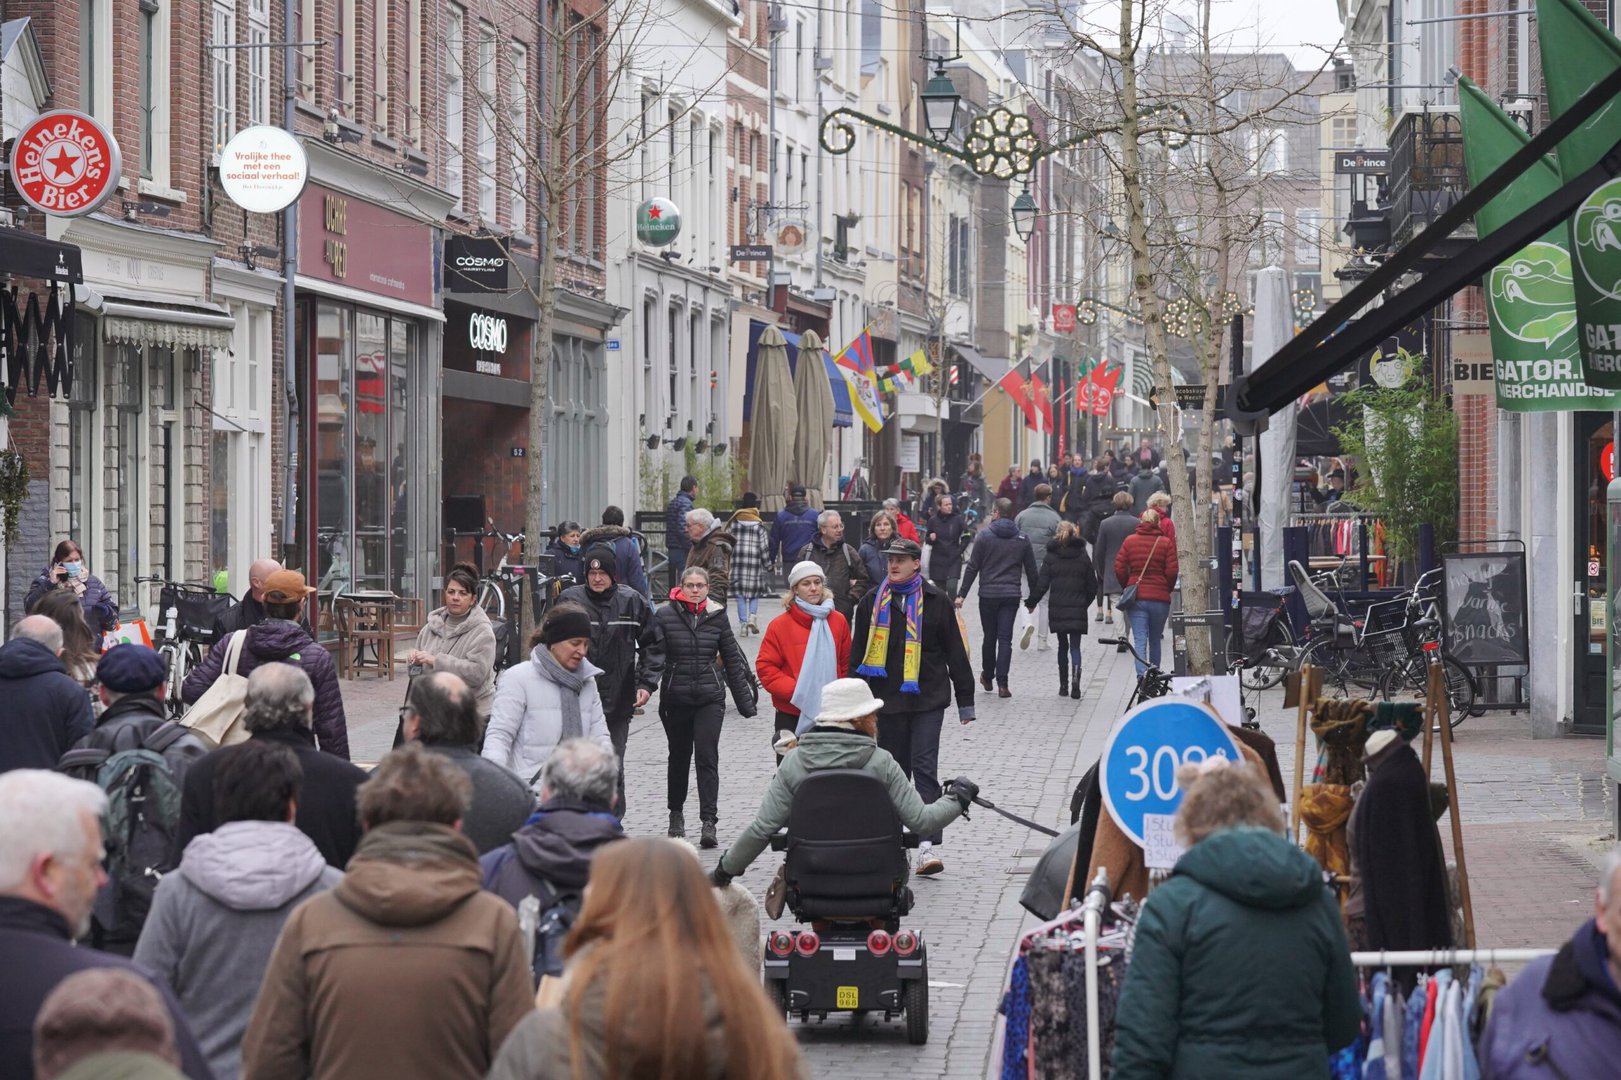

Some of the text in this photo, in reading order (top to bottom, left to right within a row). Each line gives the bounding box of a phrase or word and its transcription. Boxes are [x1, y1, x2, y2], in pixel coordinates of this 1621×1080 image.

[19, 119, 105, 186] Heineken's
[235, 152, 292, 162] Vrolijke thee
[1342, 155, 1386, 168] De Prince
[226, 171, 300, 180] sociaal verhaal!
[39, 184, 91, 209] Bier
[637, 223, 676, 231] Heineken
[456, 257, 504, 267] COSMO
[469, 312, 508, 354] COSMO
[1454, 363, 1494, 381] BIE
[513, 448, 523, 456] 52
[838, 991, 857, 999] DSL
